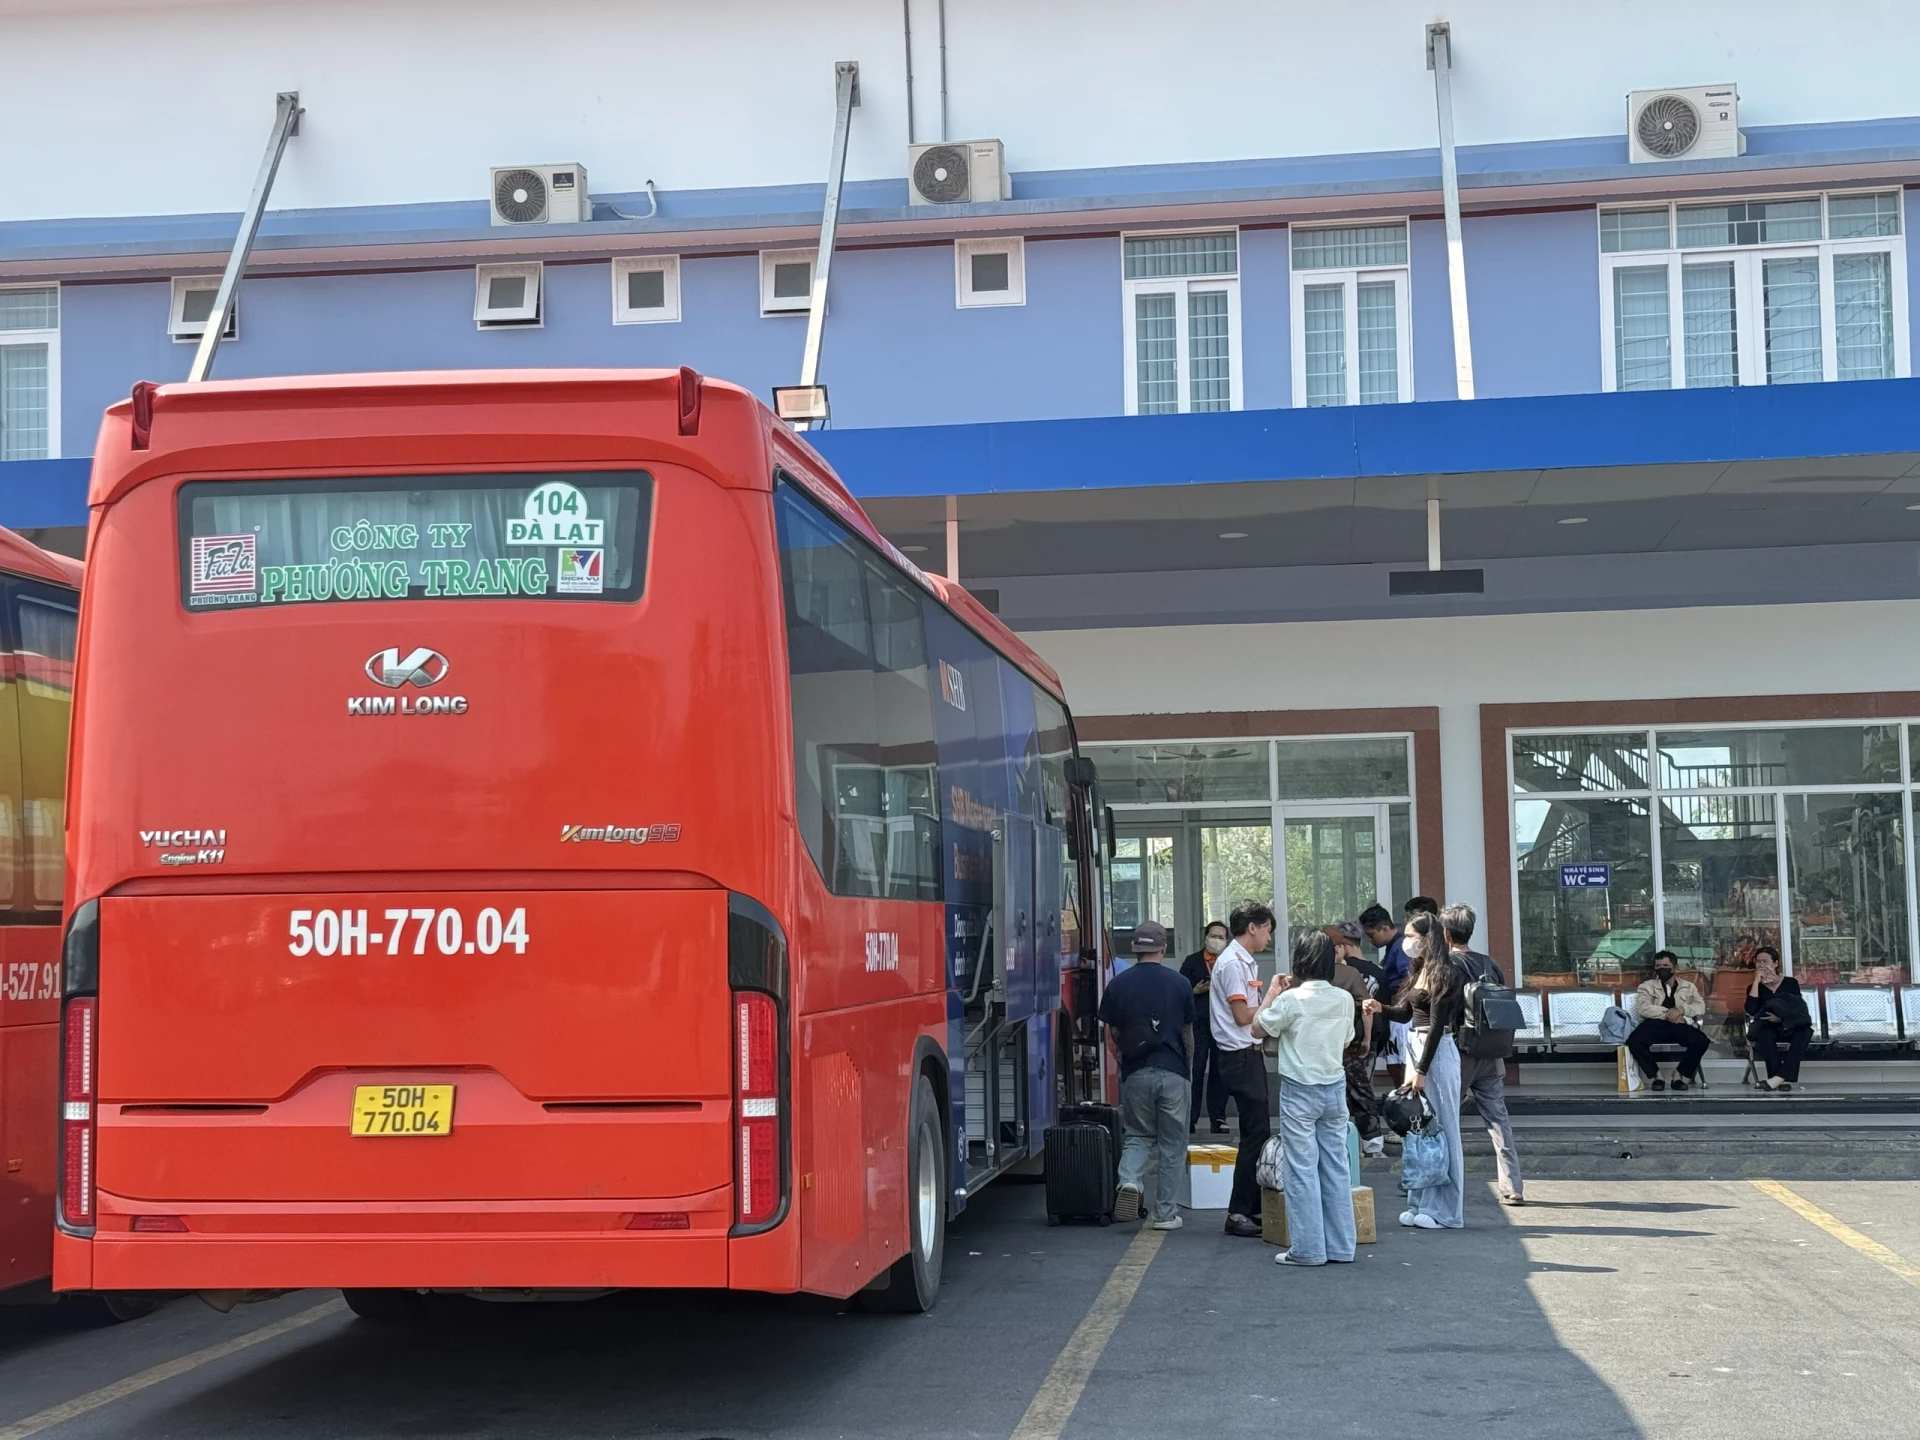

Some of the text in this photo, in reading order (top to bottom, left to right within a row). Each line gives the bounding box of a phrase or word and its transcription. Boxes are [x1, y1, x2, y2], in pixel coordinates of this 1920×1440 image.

[533, 490, 579, 516] 104
[331, 518, 472, 551] CÔNG TY
[511, 519, 600, 544] ĐÀ LẠT
[260, 556, 549, 603] PHƯƠNG TRANG
[227, 592, 257, 604] TRANG
[348, 696, 469, 715] KIM LONG
[139, 829, 227, 847] YUCHAI
[159, 849, 225, 866] Engine K11
[1564, 874, 1587, 886] WC
[289, 907, 530, 957] 50H-770.04
[382, 1087, 426, 1109] 50H
[363, 1111, 440, 1133] 770.04
